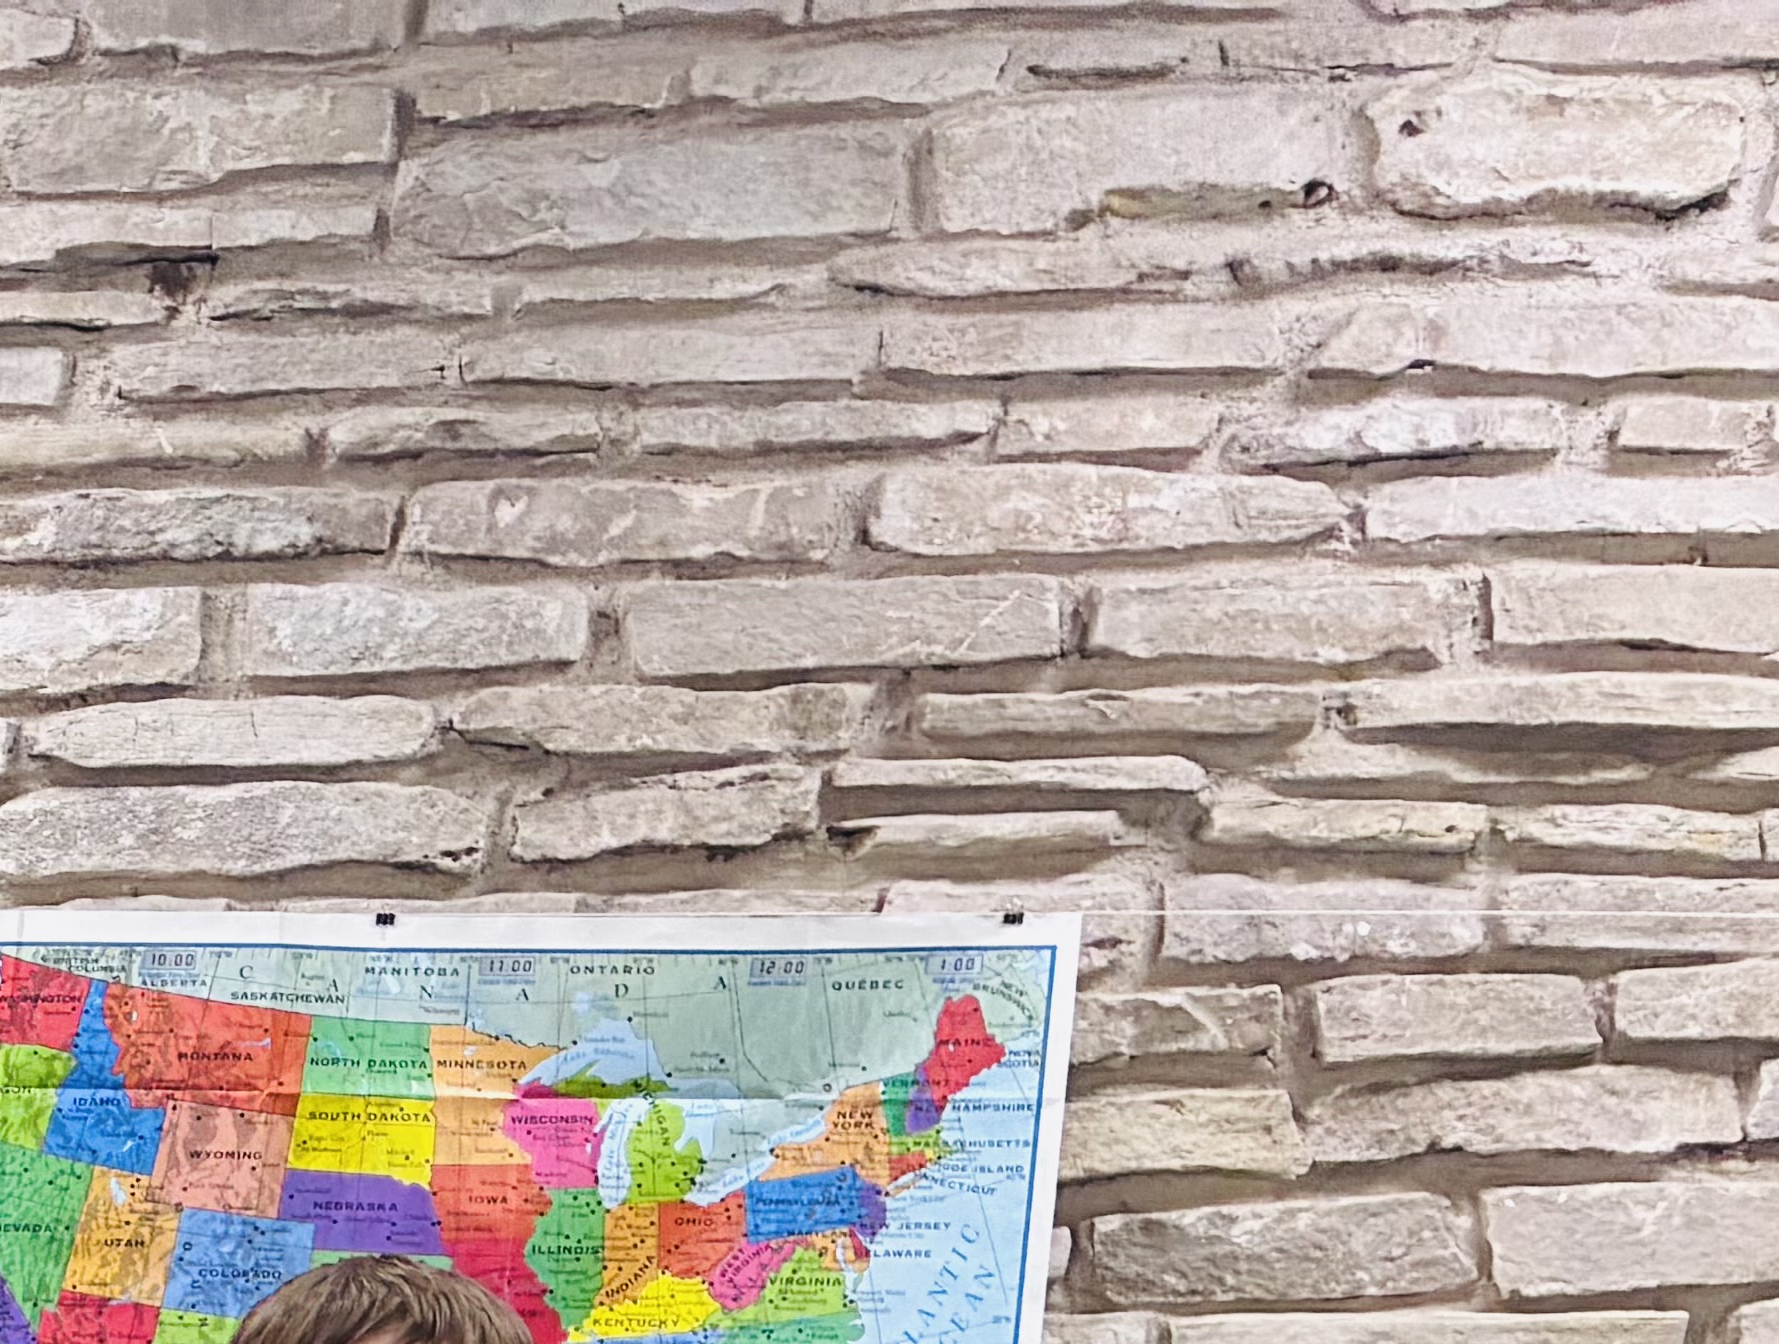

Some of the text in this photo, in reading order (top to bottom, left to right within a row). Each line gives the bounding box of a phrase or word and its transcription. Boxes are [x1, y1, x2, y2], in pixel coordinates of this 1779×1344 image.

[365, 965, 460, 978] MANITOBA
[570, 964, 656, 976] ONTARIO
[141, 978, 207, 988] ALBERTA
[230, 990, 346, 1005] SASKATCHEWAN
[938, 1038, 994, 1049] MAINE
[177, 1051, 254, 1063] MONTANA
[310, 1056, 428, 1070] NORTH DAKOTA
[436, 1059, 528, 1071] MINNESOTA
[73, 1096, 122, 1107] IDAHO
[952, 1103, 1035, 1113] HAMPSHIRE
[307, 1111, 431, 1123] SOUTH DAKOTA
[510, 1114, 593, 1125] WISCONSIN
[837, 1110, 874, 1121] NEW
[831, 1121, 876, 1131] YORK
[912, 1138, 1031, 1149] MASSACHUSETTS
[189, 1150, 263, 1162] WYOMING
[973, 1164, 1025, 1174] ISLAND
[468, 1195, 509, 1205] IOWA
[312, 1200, 399, 1213] NEBRASKA
[674, 1216, 715, 1227] OHIO
[897, 1221, 952, 1231] JERSEY
[104, 1238, 147, 1248] UTAH
[532, 1244, 603, 1256] ILLINOIS
[198, 1267, 283, 1281] COLORADO
[605, 1254, 657, 1299] INDIANA
[769, 1276, 842, 1287] VIRGINIA
[592, 1317, 681, 1329] KENTUCKY
